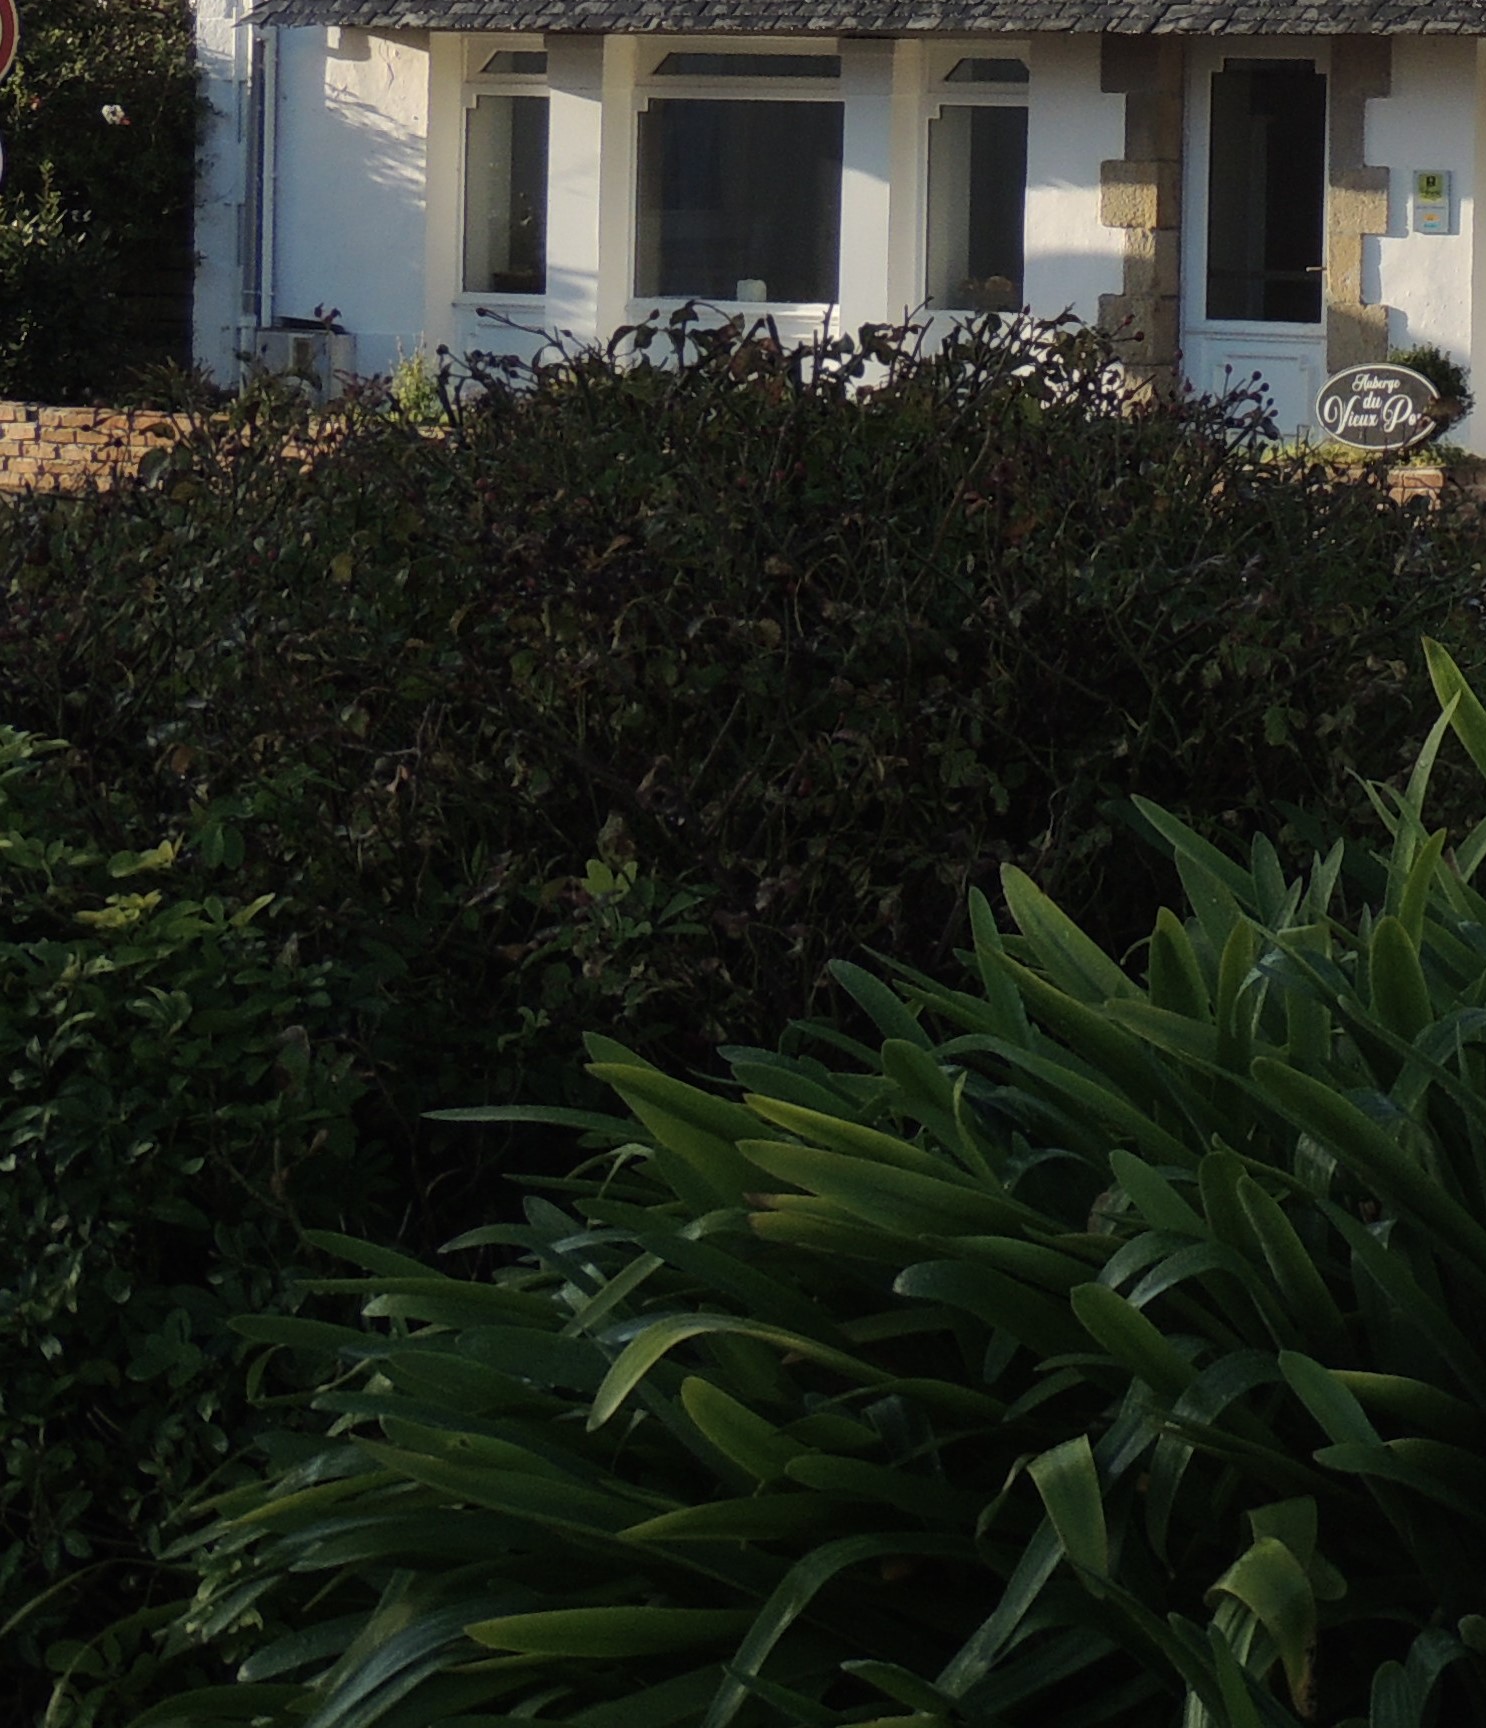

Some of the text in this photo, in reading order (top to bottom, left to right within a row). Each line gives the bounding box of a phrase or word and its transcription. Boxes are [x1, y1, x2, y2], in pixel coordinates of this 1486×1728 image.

[1352, 374, 1400, 393] Auberge
[1363, 391, 1382, 409] du
[1324, 394, 1421, 434] Vieux Po
